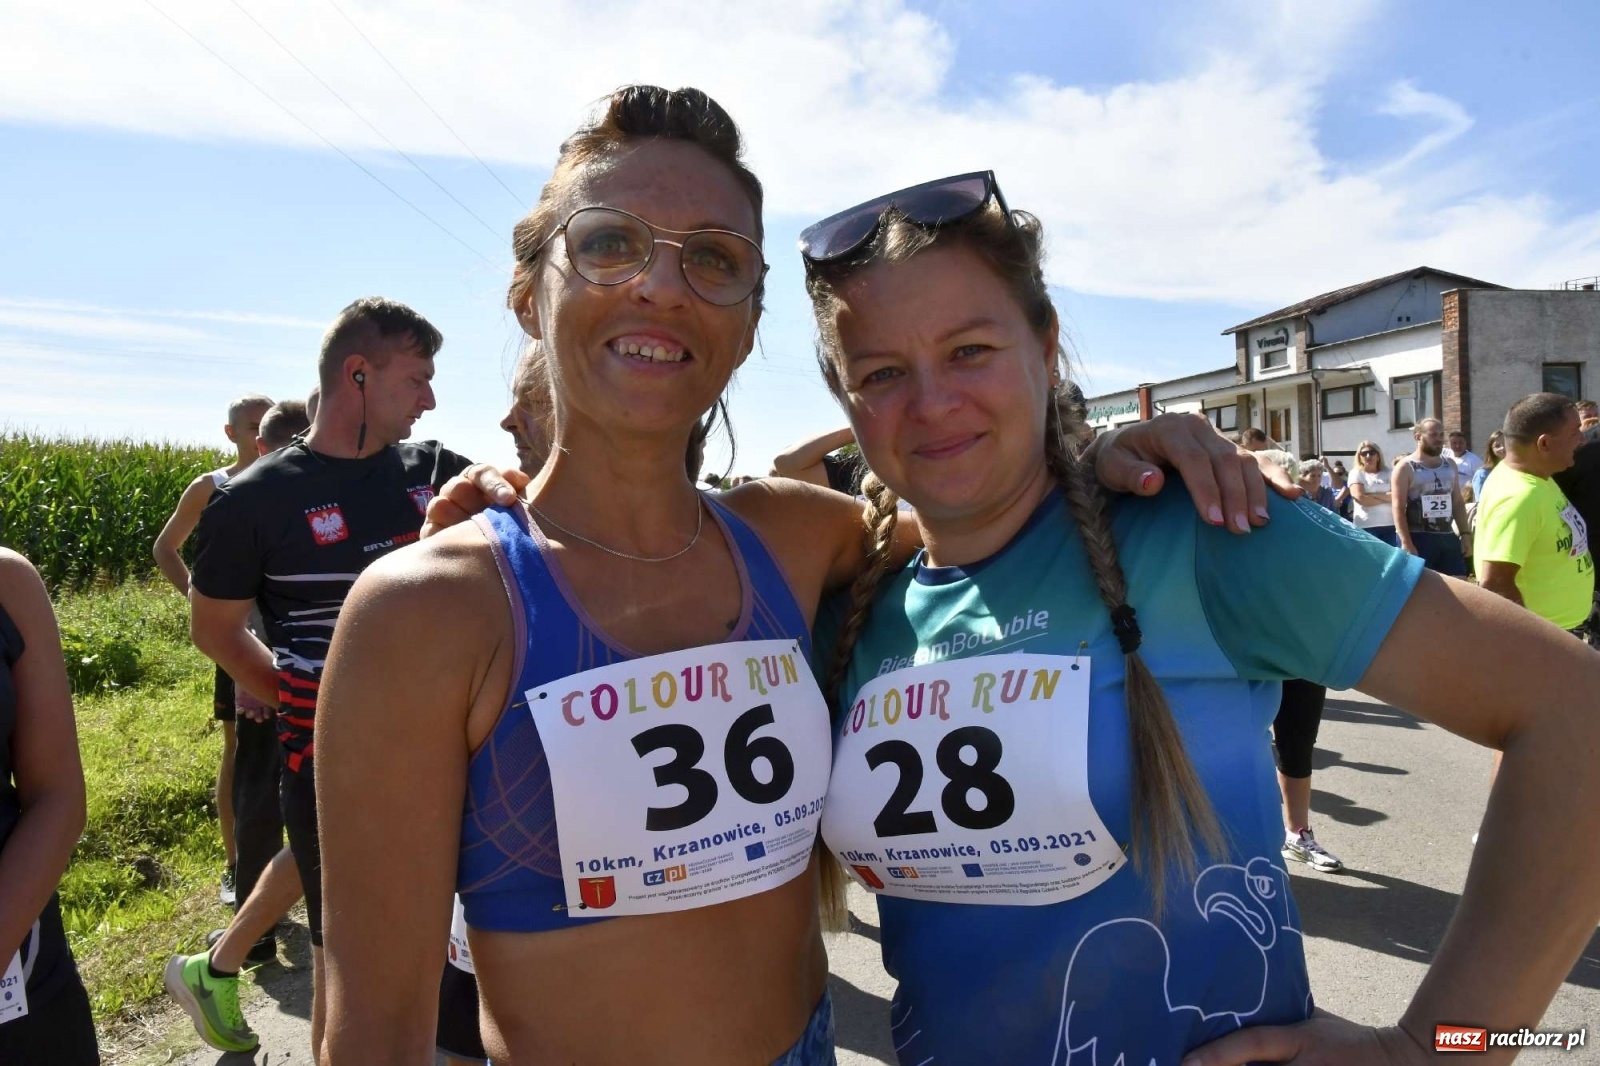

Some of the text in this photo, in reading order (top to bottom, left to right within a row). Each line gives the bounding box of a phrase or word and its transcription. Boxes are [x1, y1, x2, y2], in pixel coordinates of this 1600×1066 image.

[304, 502, 338, 514] POLSKA
[1430, 500, 1447, 510] 25
[561, 654, 799, 727] COLOUR RUN
[842, 669, 1062, 737] COLOUR RUN
[630, 703, 795, 832] 36
[865, 726, 1015, 838] 28
[575, 854, 644, 874] 10km,
[653, 822, 766, 862] Krzanowice,
[774, 797, 825, 827] 05.09.202
[840, 830, 1097, 863] 10km, Krzanowice, 05.09.2021
